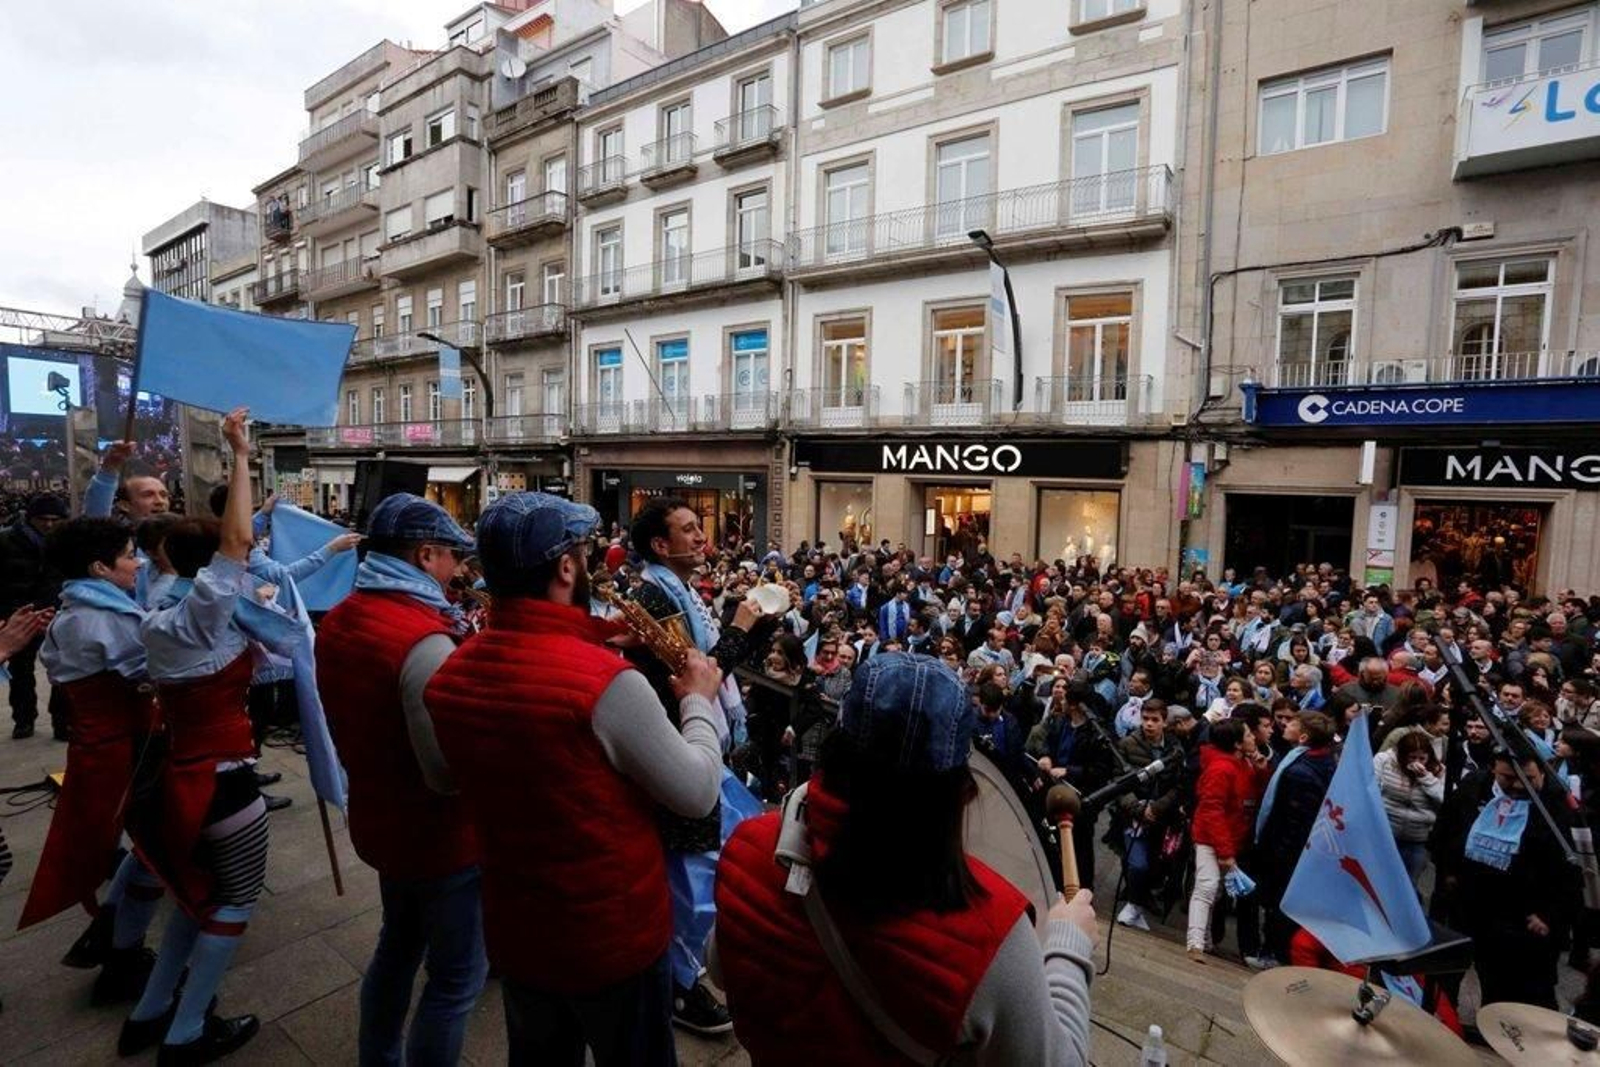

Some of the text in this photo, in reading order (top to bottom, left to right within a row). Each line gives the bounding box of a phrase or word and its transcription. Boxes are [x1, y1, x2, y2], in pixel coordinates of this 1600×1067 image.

[1332, 400, 1410, 415] CADENA
[1411, 397, 1464, 414] COPE
[882, 444, 1022, 472] MANGO
[1445, 455, 1600, 483] MANG
